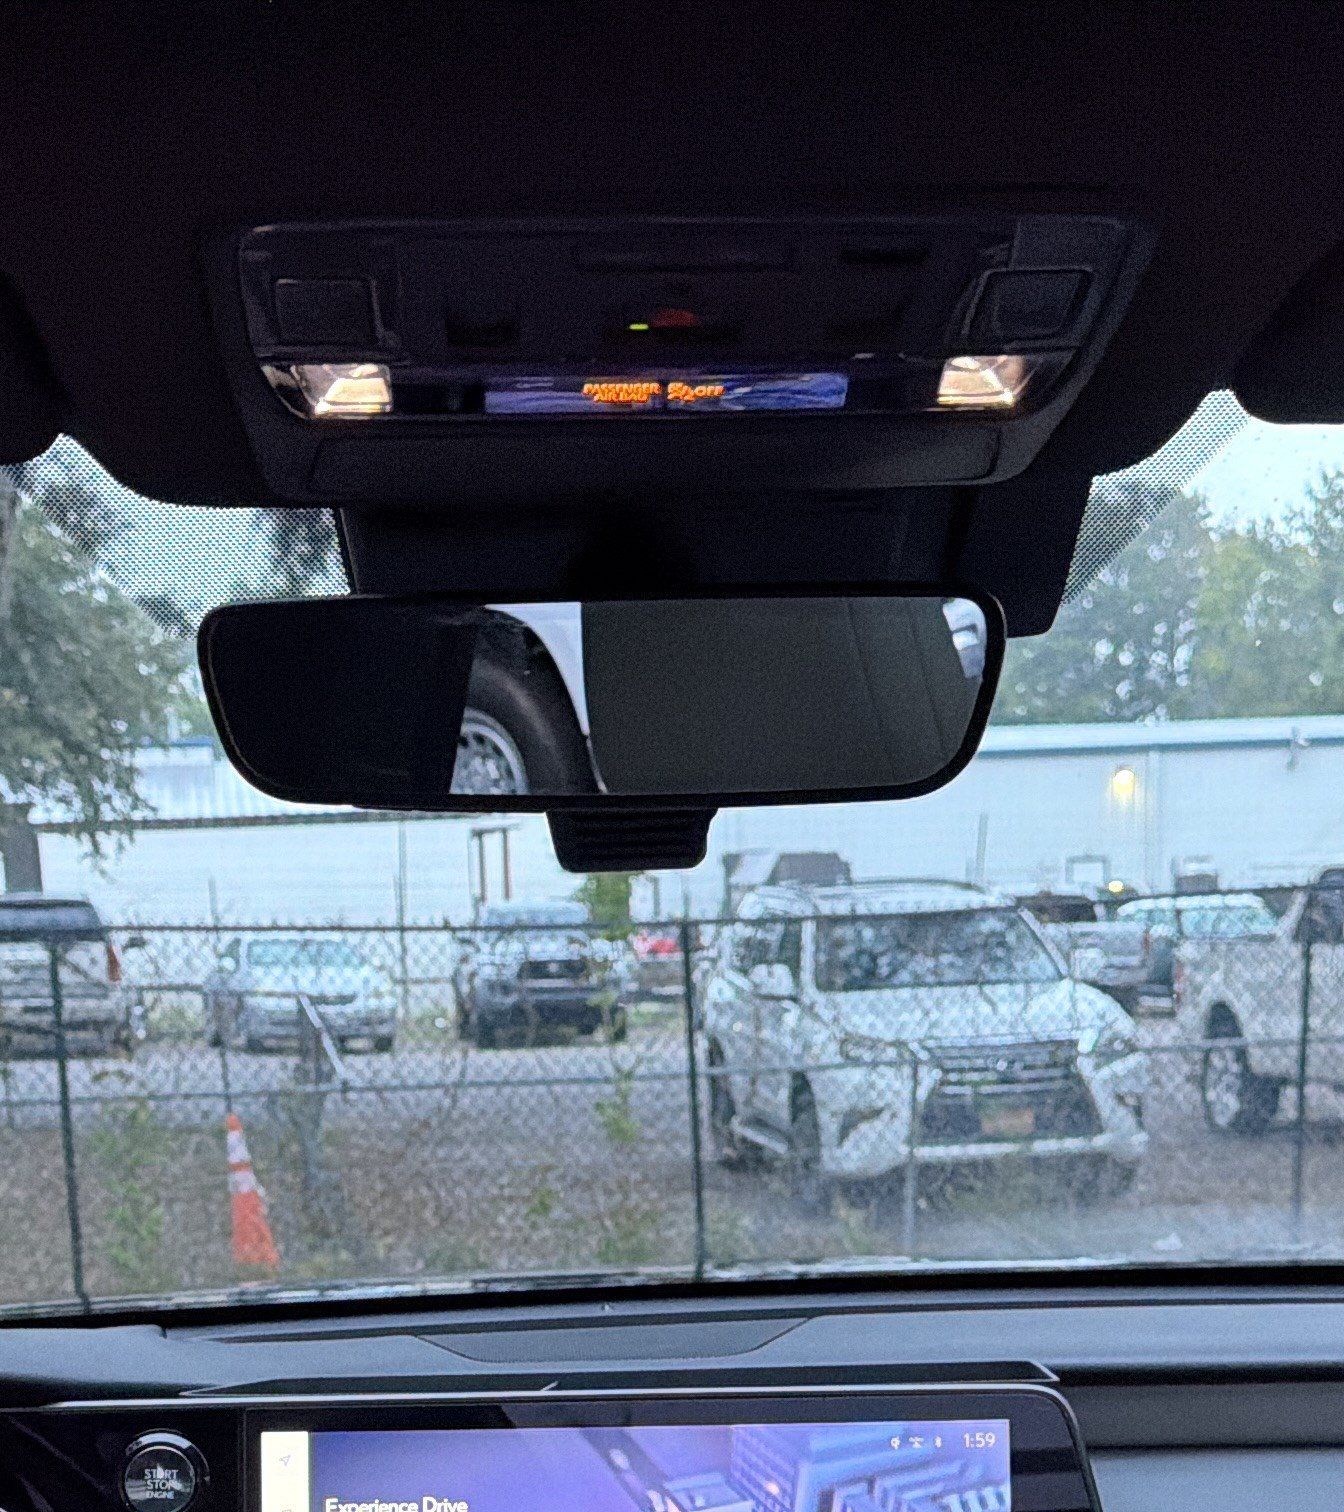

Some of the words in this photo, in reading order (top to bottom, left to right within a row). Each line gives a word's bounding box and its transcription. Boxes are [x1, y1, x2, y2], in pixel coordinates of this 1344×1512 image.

[582, 382, 661, 396] PASSENGER
[694, 385, 727, 398] OFF
[963, 1432, 996, 1449] 1:59
